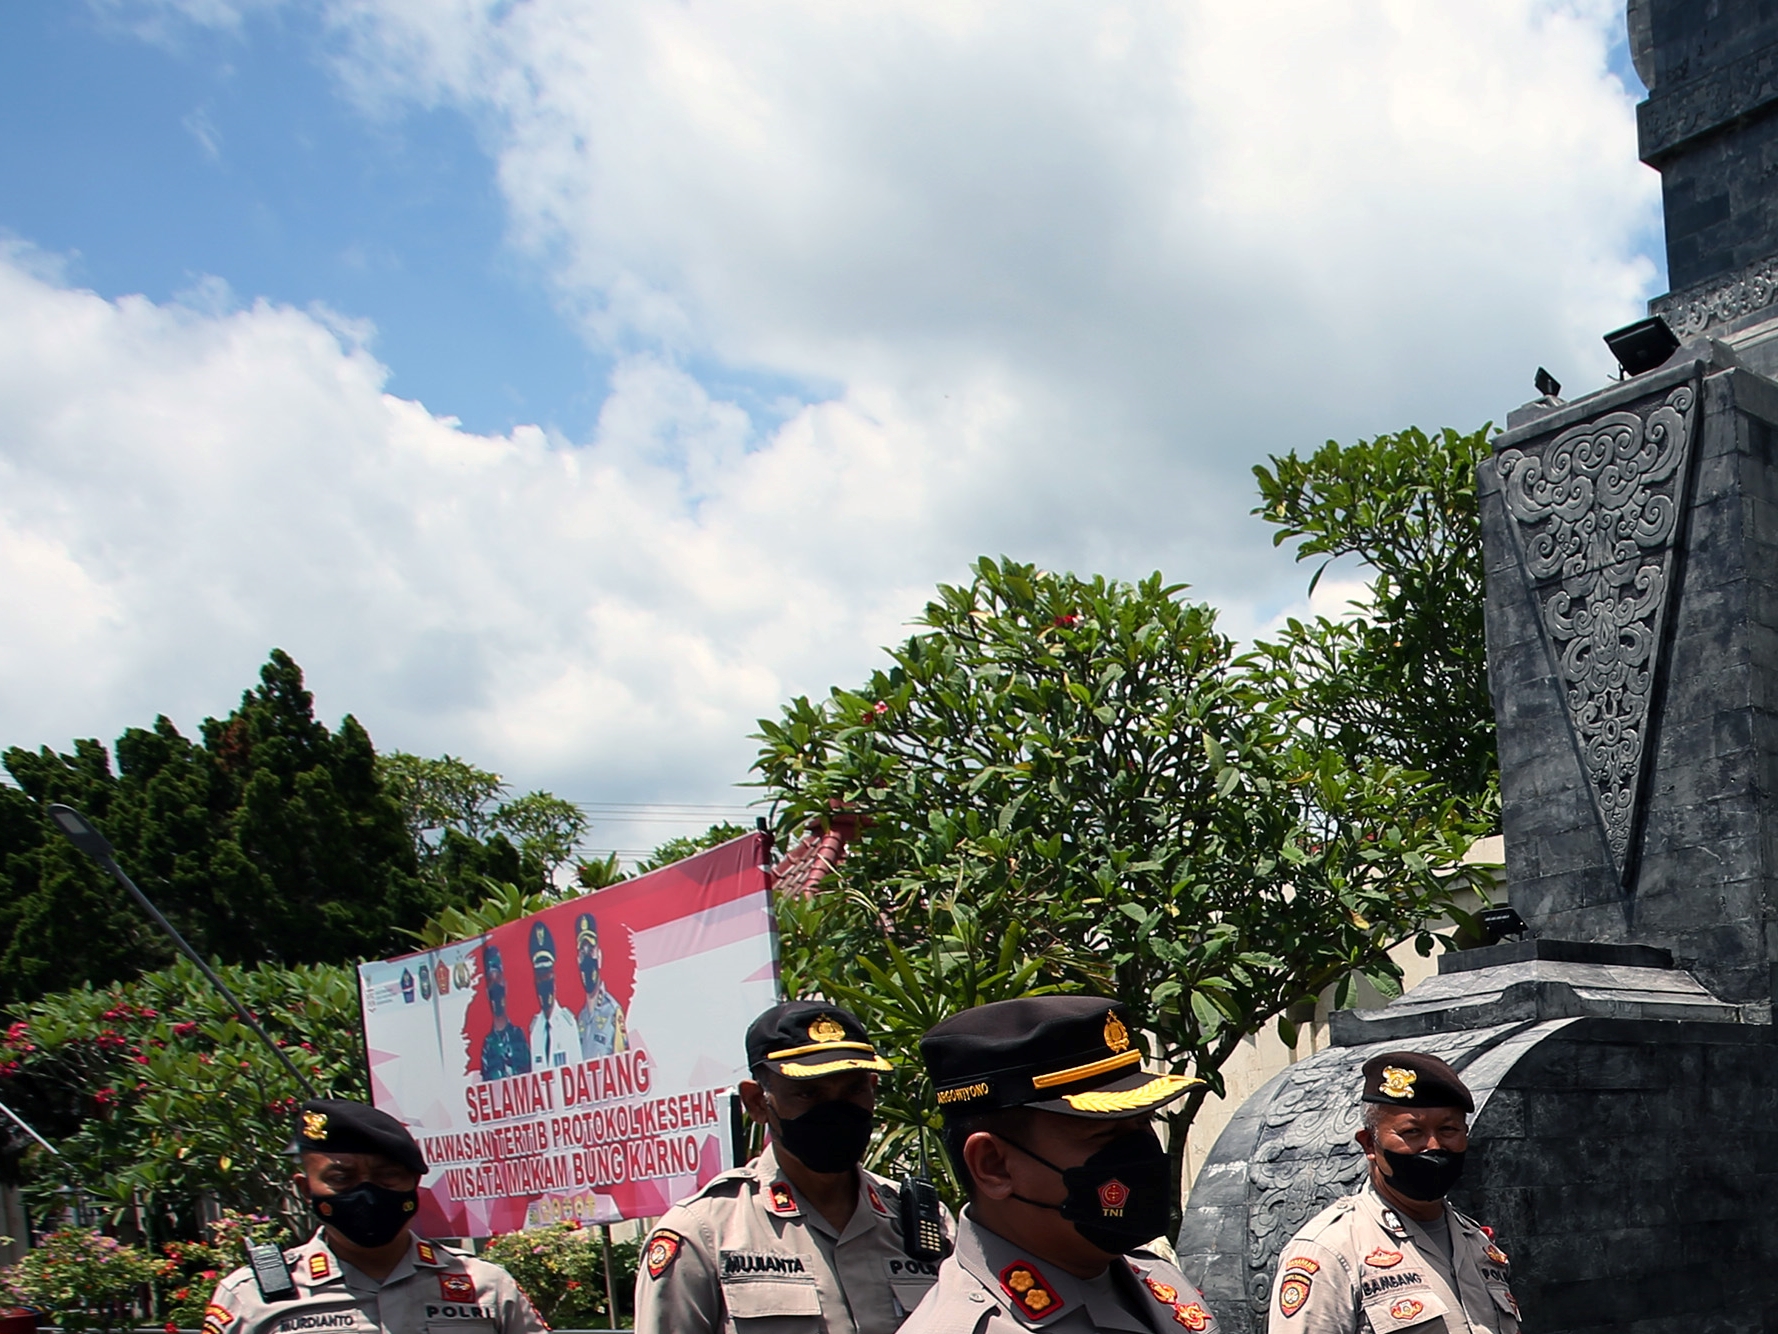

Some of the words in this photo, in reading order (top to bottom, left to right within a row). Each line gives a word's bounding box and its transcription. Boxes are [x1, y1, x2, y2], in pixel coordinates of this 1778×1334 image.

[465, 1070, 555, 1125] SELAMAT
[560, 1049, 650, 1107] DATANG
[423, 1129, 495, 1164] KAWASAN
[494, 1120, 548, 1158] TERTIB
[551, 1104, 641, 1148] PROTOKOL
[445, 1164, 504, 1200] WISATA
[506, 1154, 569, 1197] MAKAM
[572, 1145, 624, 1186] BUNG
[627, 1134, 699, 1179] KARNO
[1102, 1208, 1124, 1217] TNI
[1362, 1272, 1422, 1297] BAMBANG
[425, 1304, 492, 1319] POLRI
